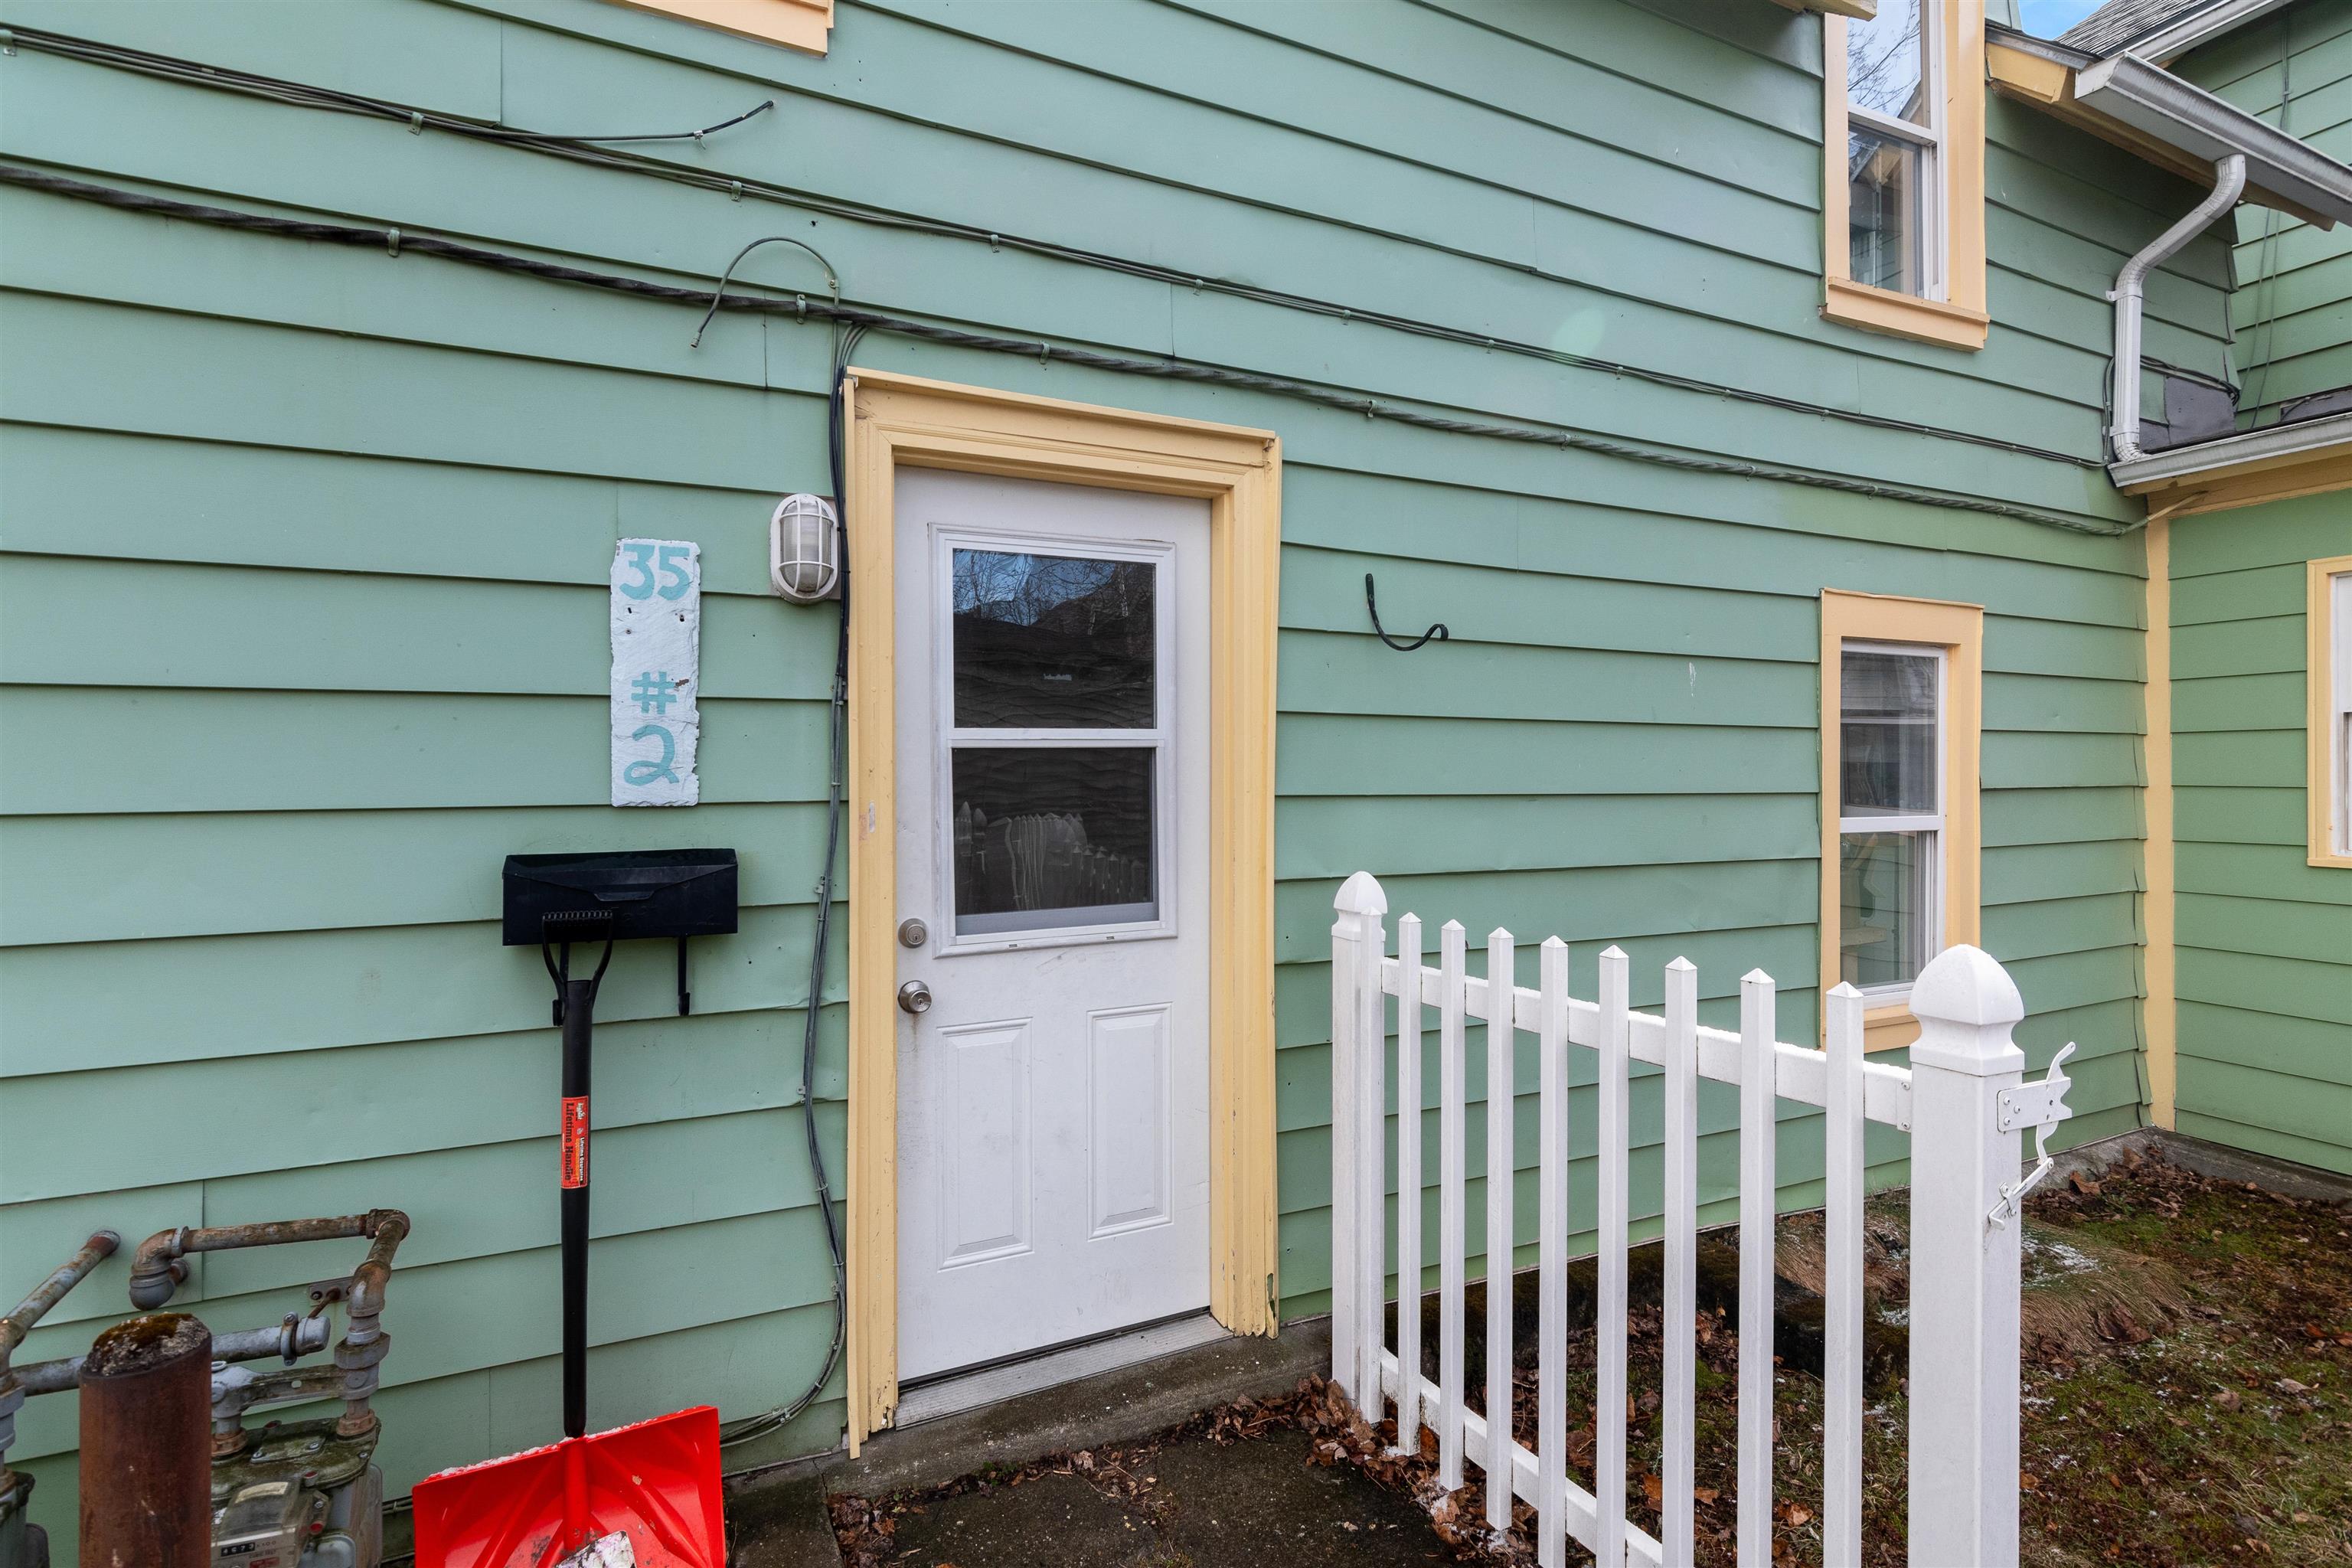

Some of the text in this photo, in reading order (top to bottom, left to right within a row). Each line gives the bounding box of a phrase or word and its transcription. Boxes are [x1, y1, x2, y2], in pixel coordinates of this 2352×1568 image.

[619, 543, 691, 602] 35
[631, 671, 678, 715] #
[623, 724, 680, 787] 2
[564, 1102, 574, 1181] Lifetime Handle
